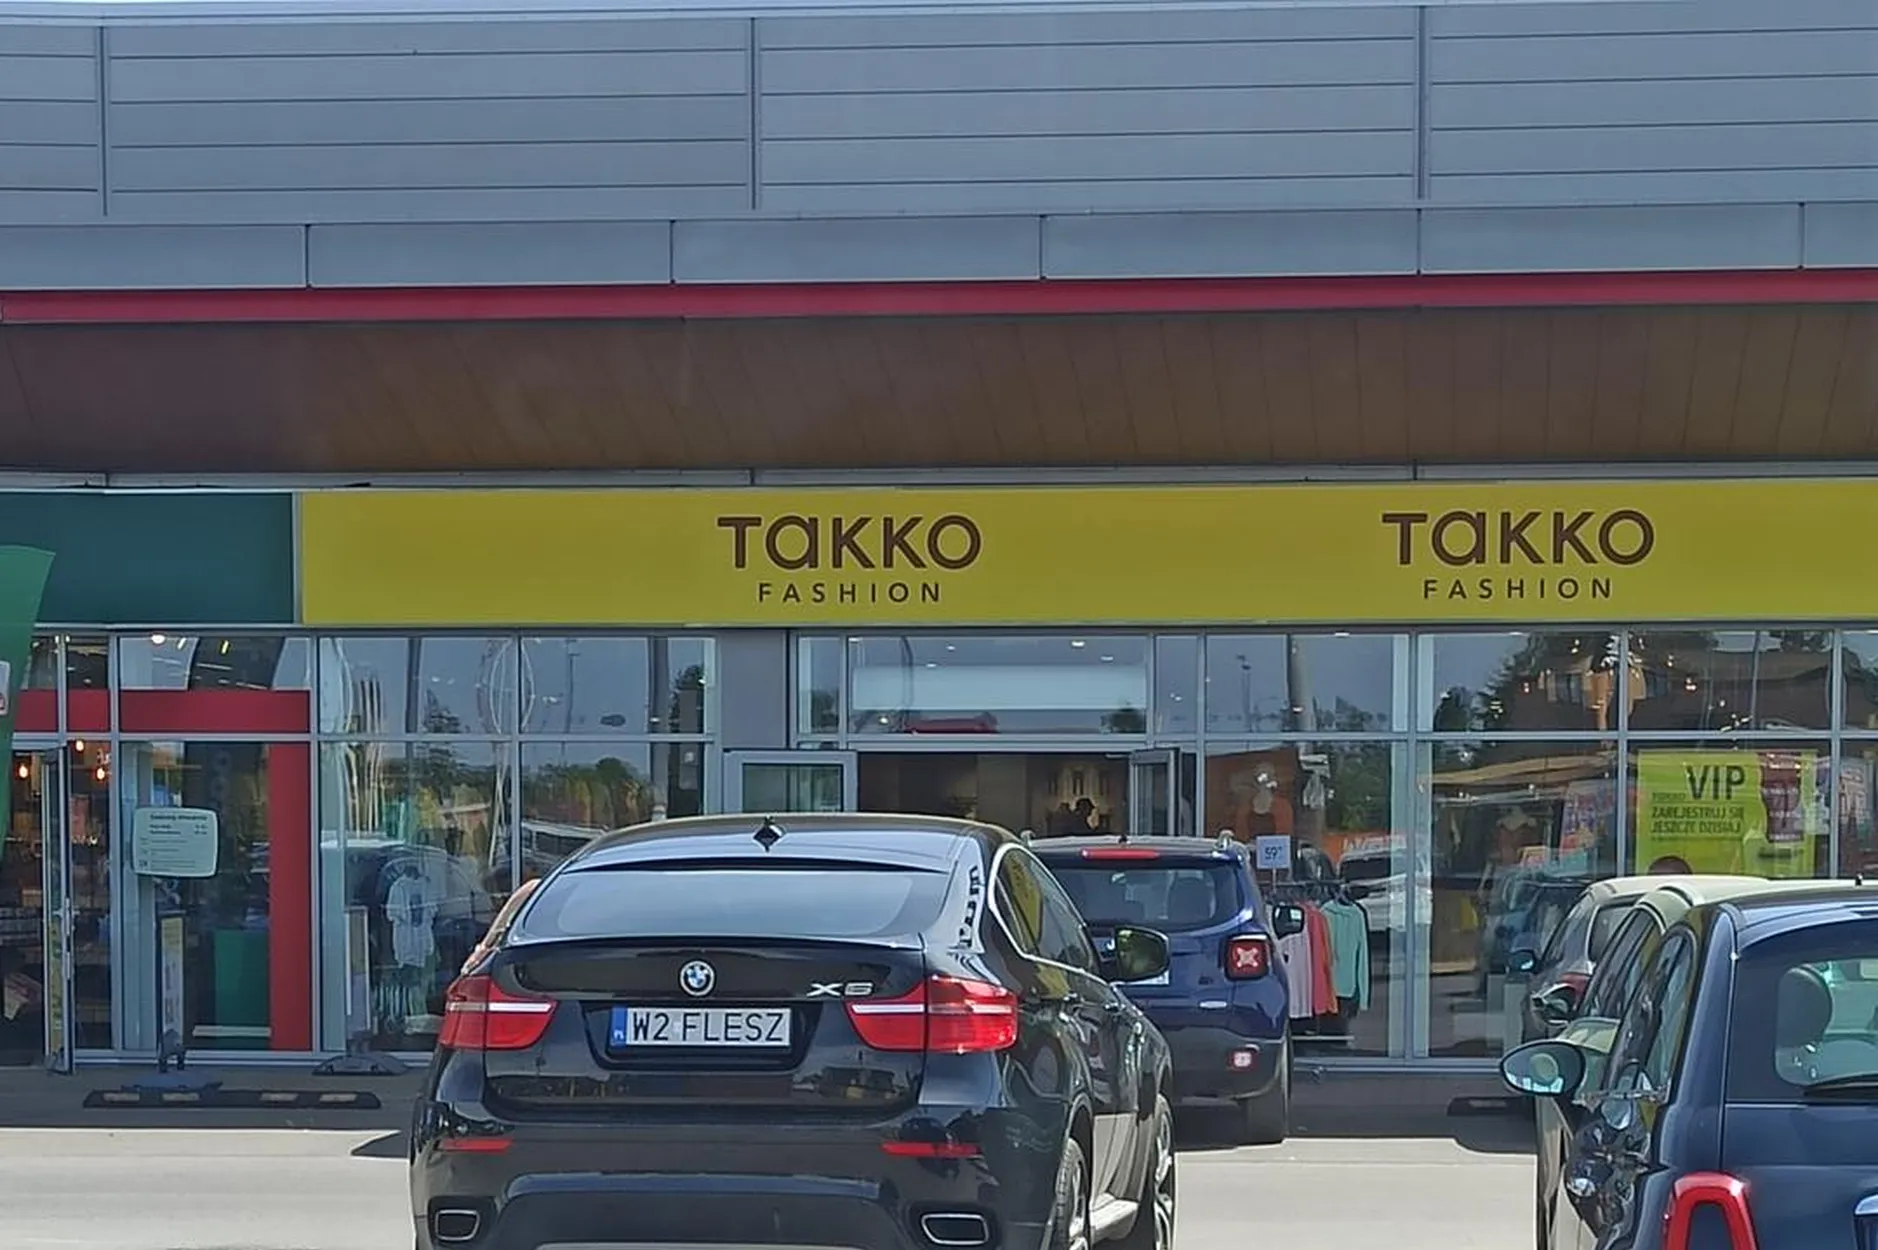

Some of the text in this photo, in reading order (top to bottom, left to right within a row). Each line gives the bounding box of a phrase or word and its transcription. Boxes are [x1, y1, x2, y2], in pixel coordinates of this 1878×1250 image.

[757, 582, 942, 605] FASHION
[1422, 576, 1613, 601] FASHION
[1686, 764, 1746, 800] VIP
[806, 982, 874, 997] X6
[633, 1012, 784, 1043] W2 FLESZ
